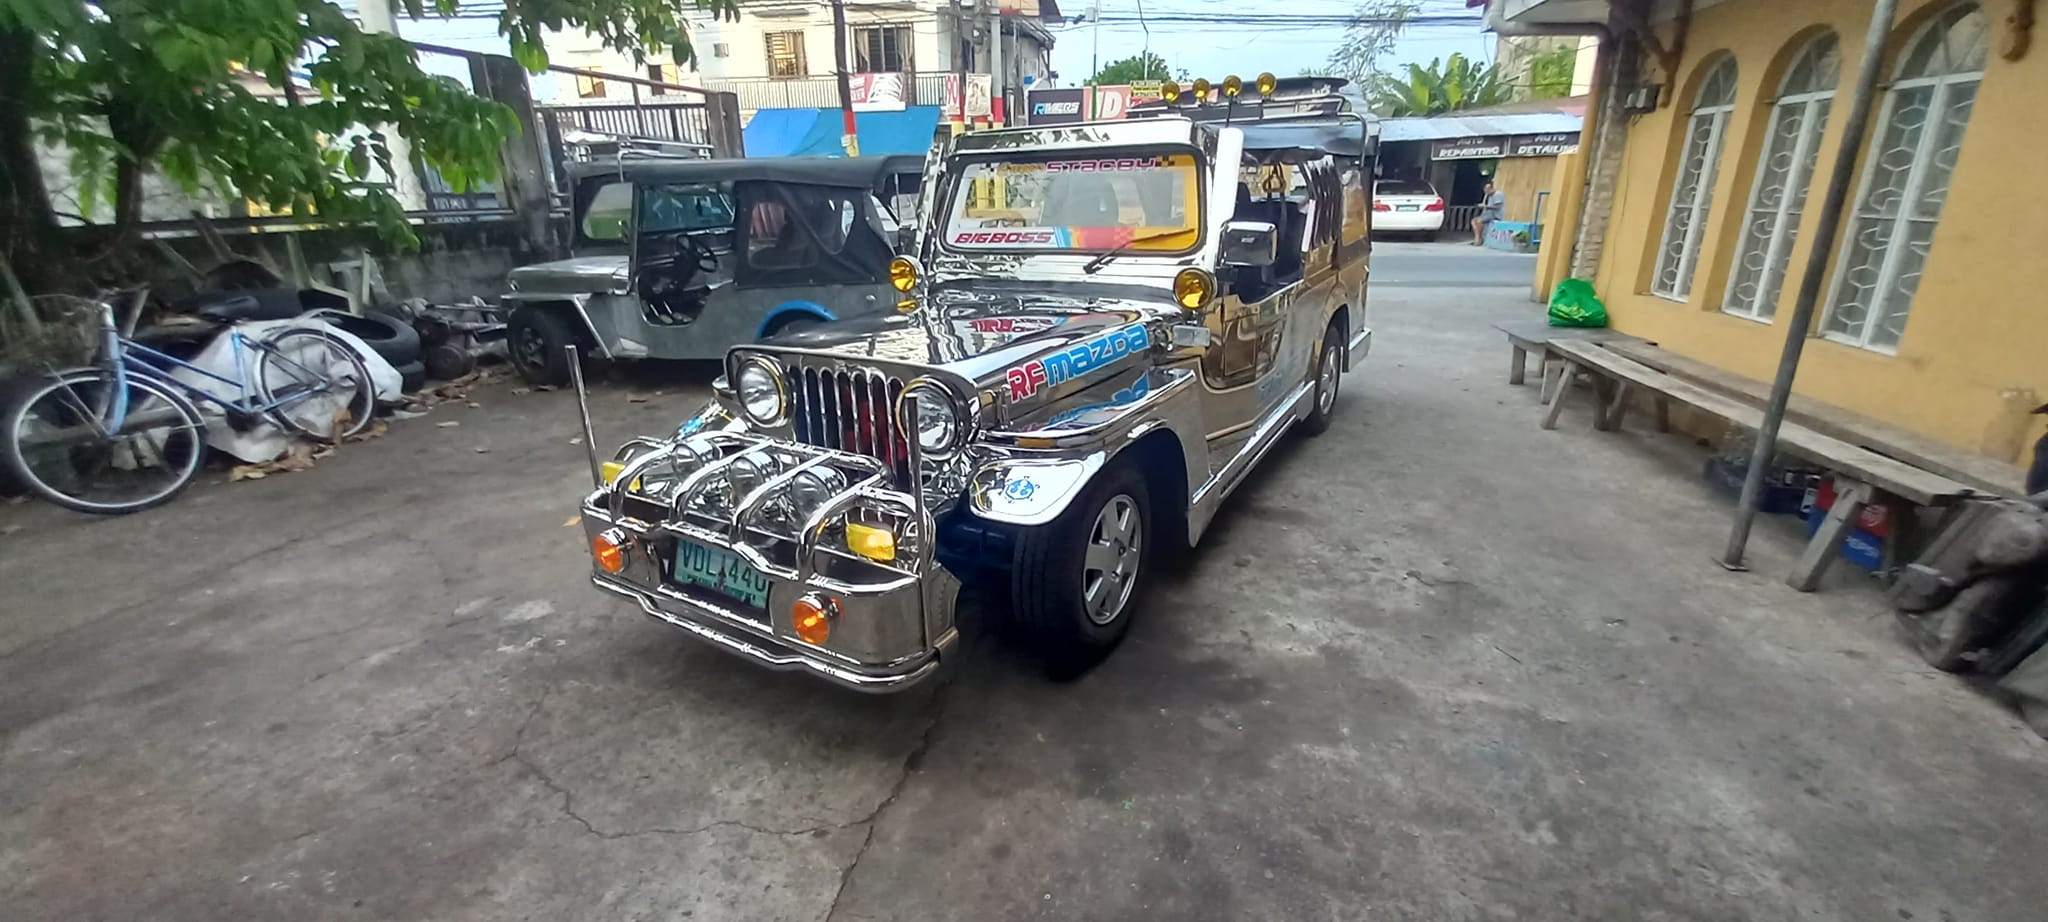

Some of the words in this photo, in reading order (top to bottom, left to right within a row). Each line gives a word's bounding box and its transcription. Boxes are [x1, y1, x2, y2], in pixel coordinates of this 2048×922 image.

[1457, 137, 1484, 146] AUTO
[1535, 134, 1567, 143] AUTO
[1439, 146, 1500, 157] REPAINTING
[1007, 360, 1046, 403] RF
[682, 541, 718, 577] VDL
